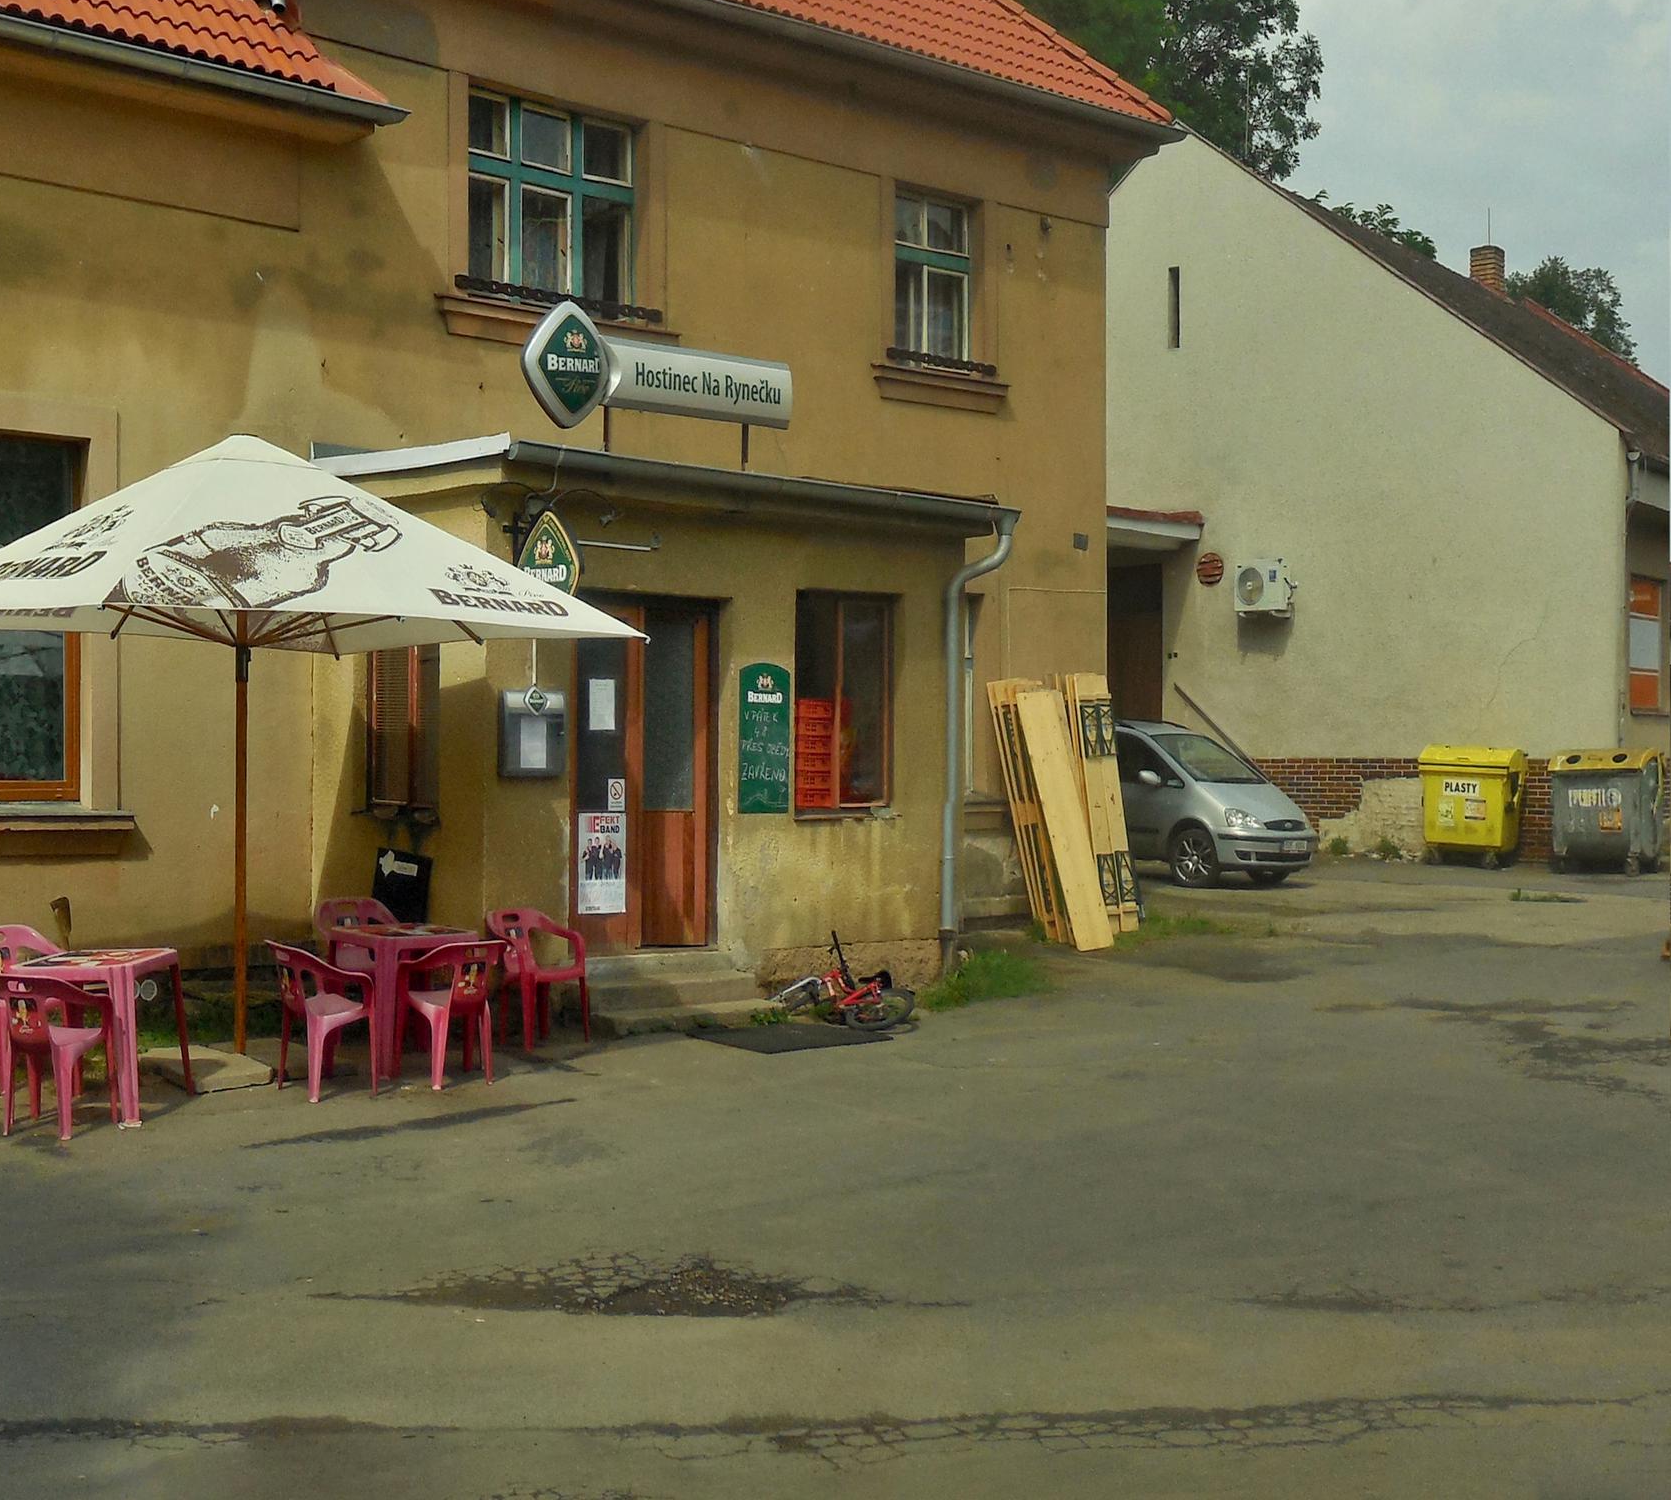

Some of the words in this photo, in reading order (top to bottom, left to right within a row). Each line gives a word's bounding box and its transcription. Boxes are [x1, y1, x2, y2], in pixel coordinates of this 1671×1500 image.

[635, 362, 698, 393] Hostinec
[702, 371, 720, 396] Na
[725, 375, 781, 405] Rynečku
[427, 587, 570, 617] BERNARD
[747, 691, 783, 703] BERNARD
[1444, 782, 1477, 793] PLASTY
[600, 825, 620, 834] BAND
